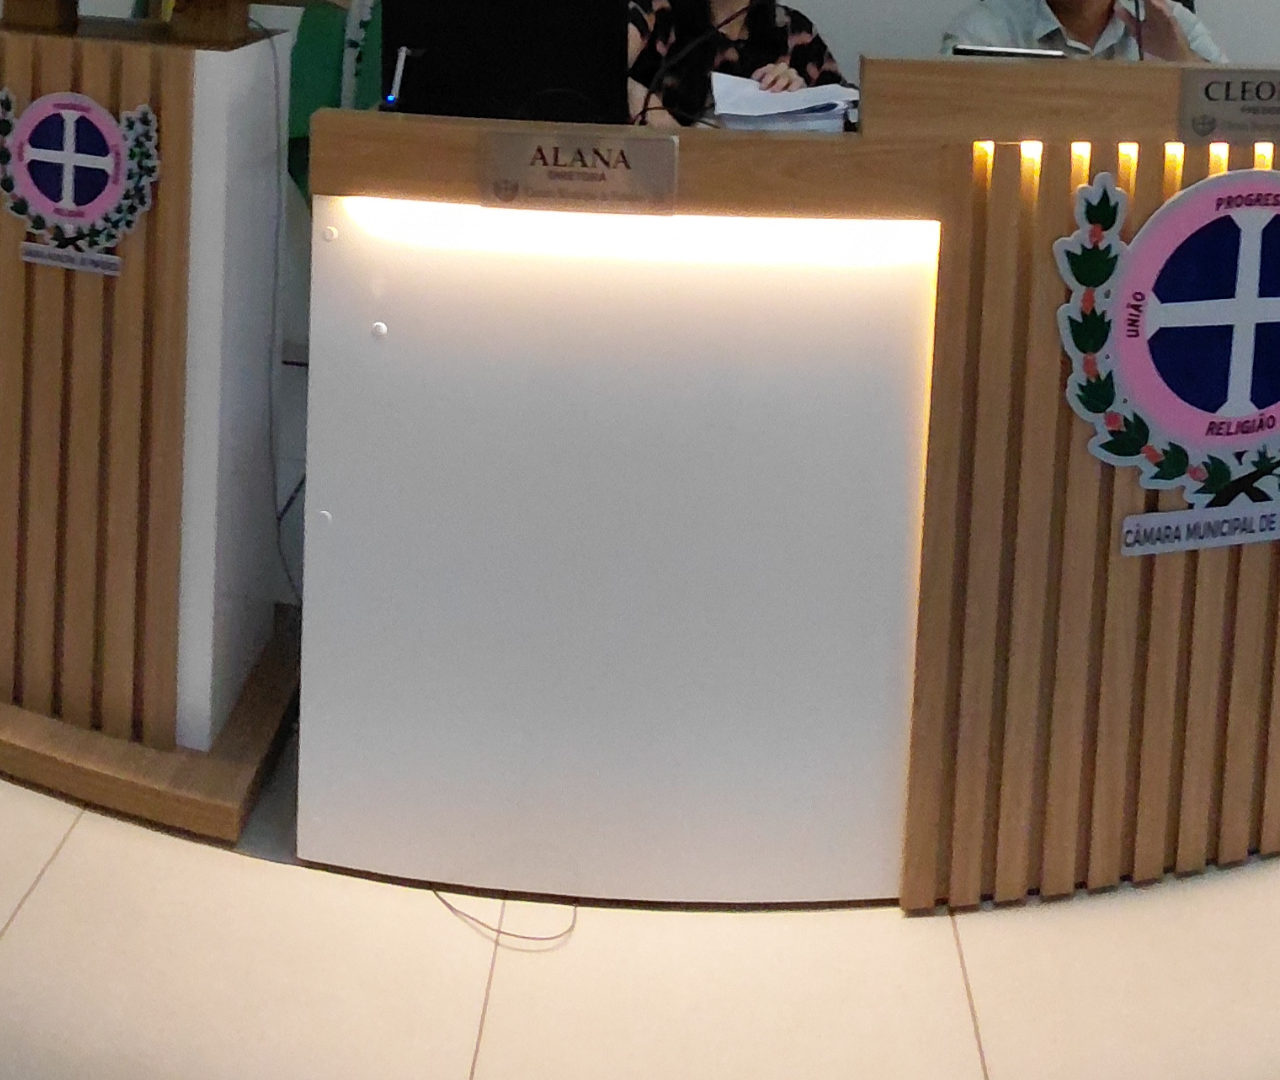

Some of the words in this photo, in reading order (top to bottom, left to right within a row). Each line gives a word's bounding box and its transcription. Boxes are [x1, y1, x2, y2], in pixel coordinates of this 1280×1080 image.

[529, 144, 632, 170] ALANA
[1126, 291, 1146, 338] UNIÃO
[1205, 414, 1276, 437] RELIGIÃO
[1124, 523, 1181, 548] CÂMARA
[1185, 516, 1256, 541] MUNICIPAL
[1259, 513, 1277, 532] DE
